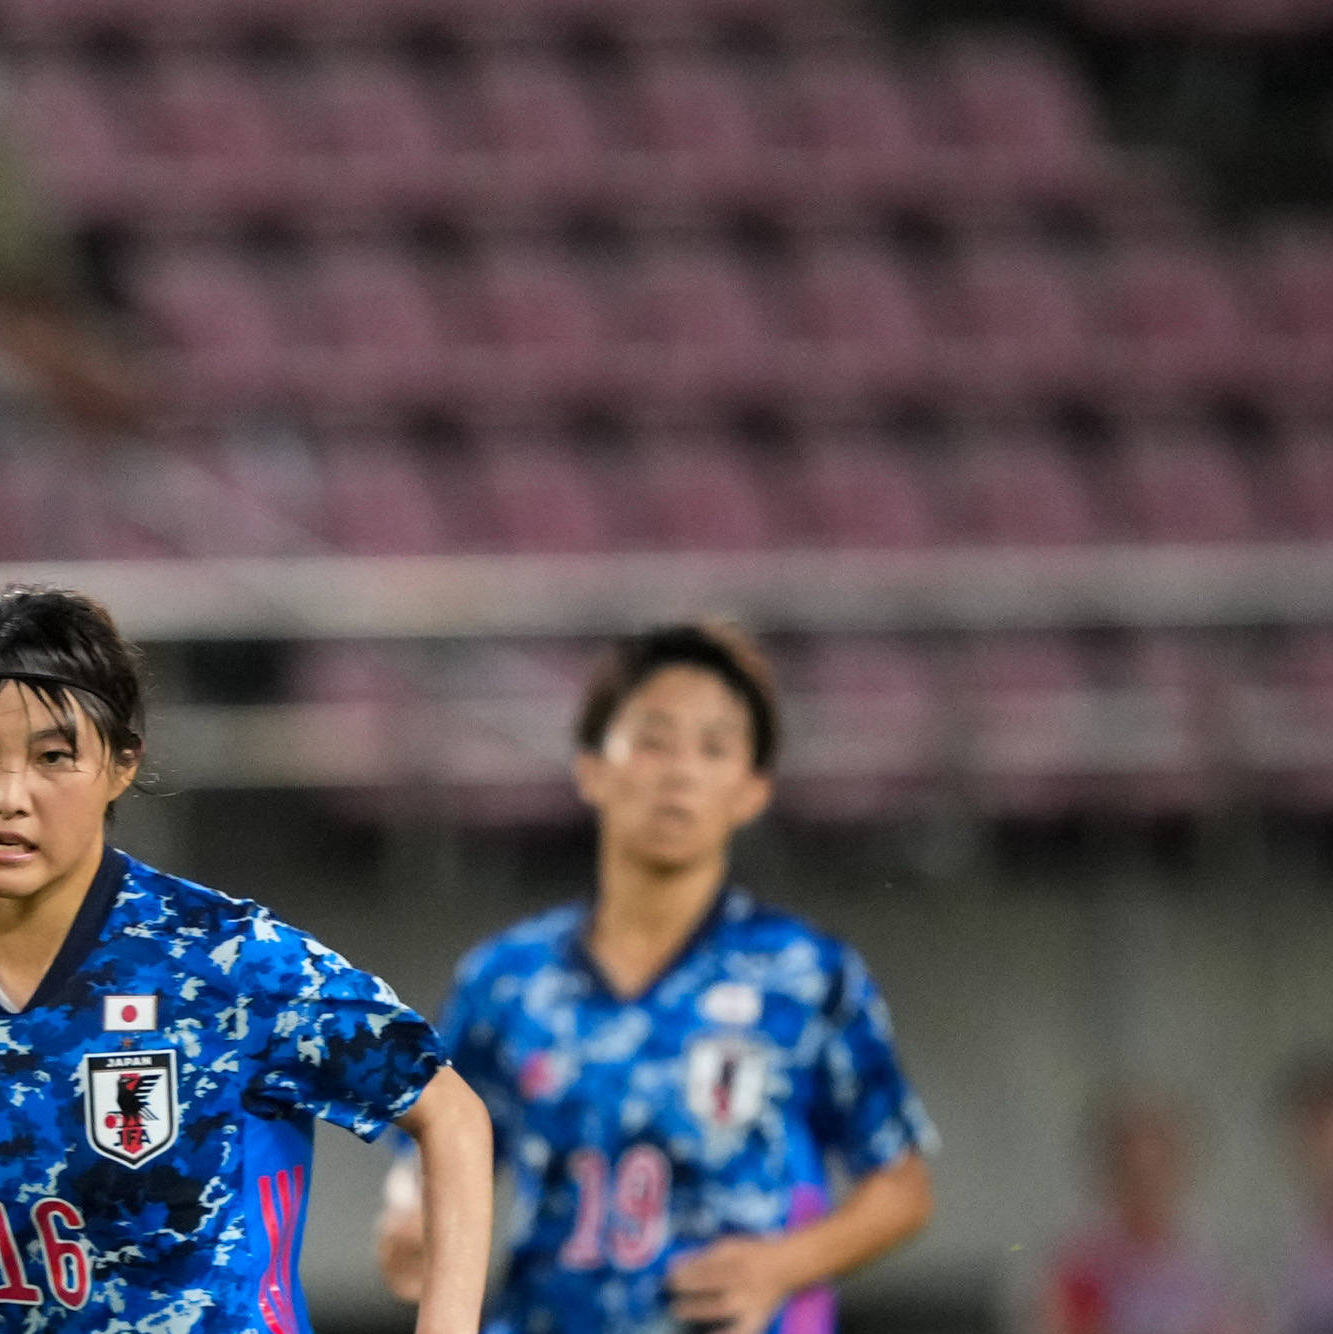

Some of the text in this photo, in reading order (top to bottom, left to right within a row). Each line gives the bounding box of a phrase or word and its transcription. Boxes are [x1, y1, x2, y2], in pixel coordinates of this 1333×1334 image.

[105, 1056, 153, 1068] JAPAN
[113, 1128, 152, 1147] JFA
[558, 1145, 672, 1270] 19
